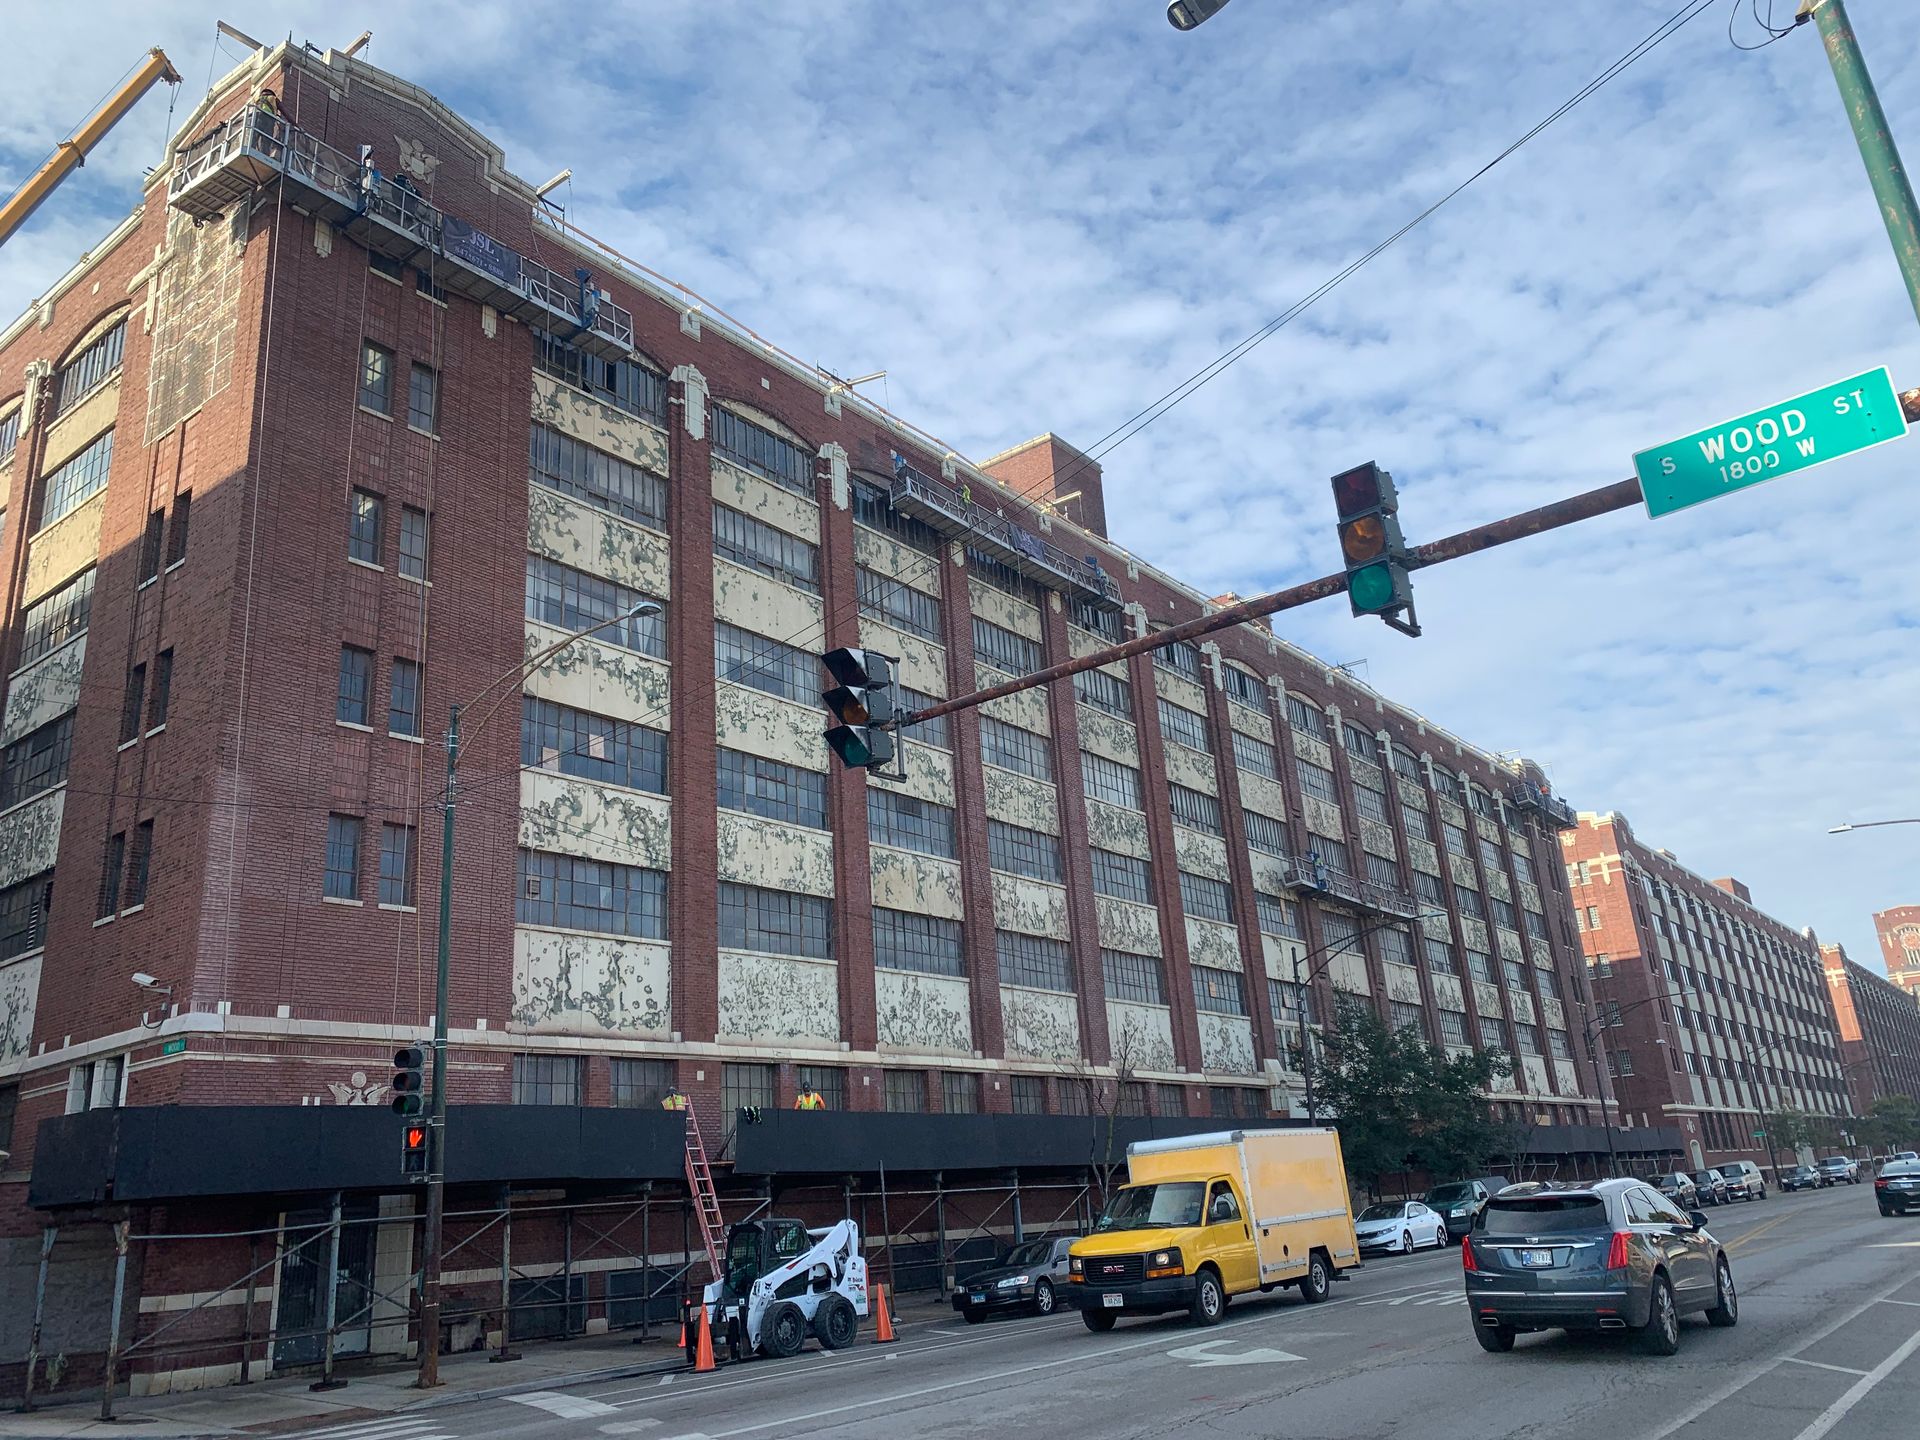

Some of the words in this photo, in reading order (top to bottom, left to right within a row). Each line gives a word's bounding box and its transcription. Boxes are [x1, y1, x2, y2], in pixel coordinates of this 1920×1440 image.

[1661, 456, 1677, 475] S
[1699, 409, 1807, 464] WOOD
[1833, 389, 1864, 415] ST
[1720, 450, 1780, 483] 1800
[1796, 437, 1816, 458] W
[1103, 1265, 1124, 1273] GMC
